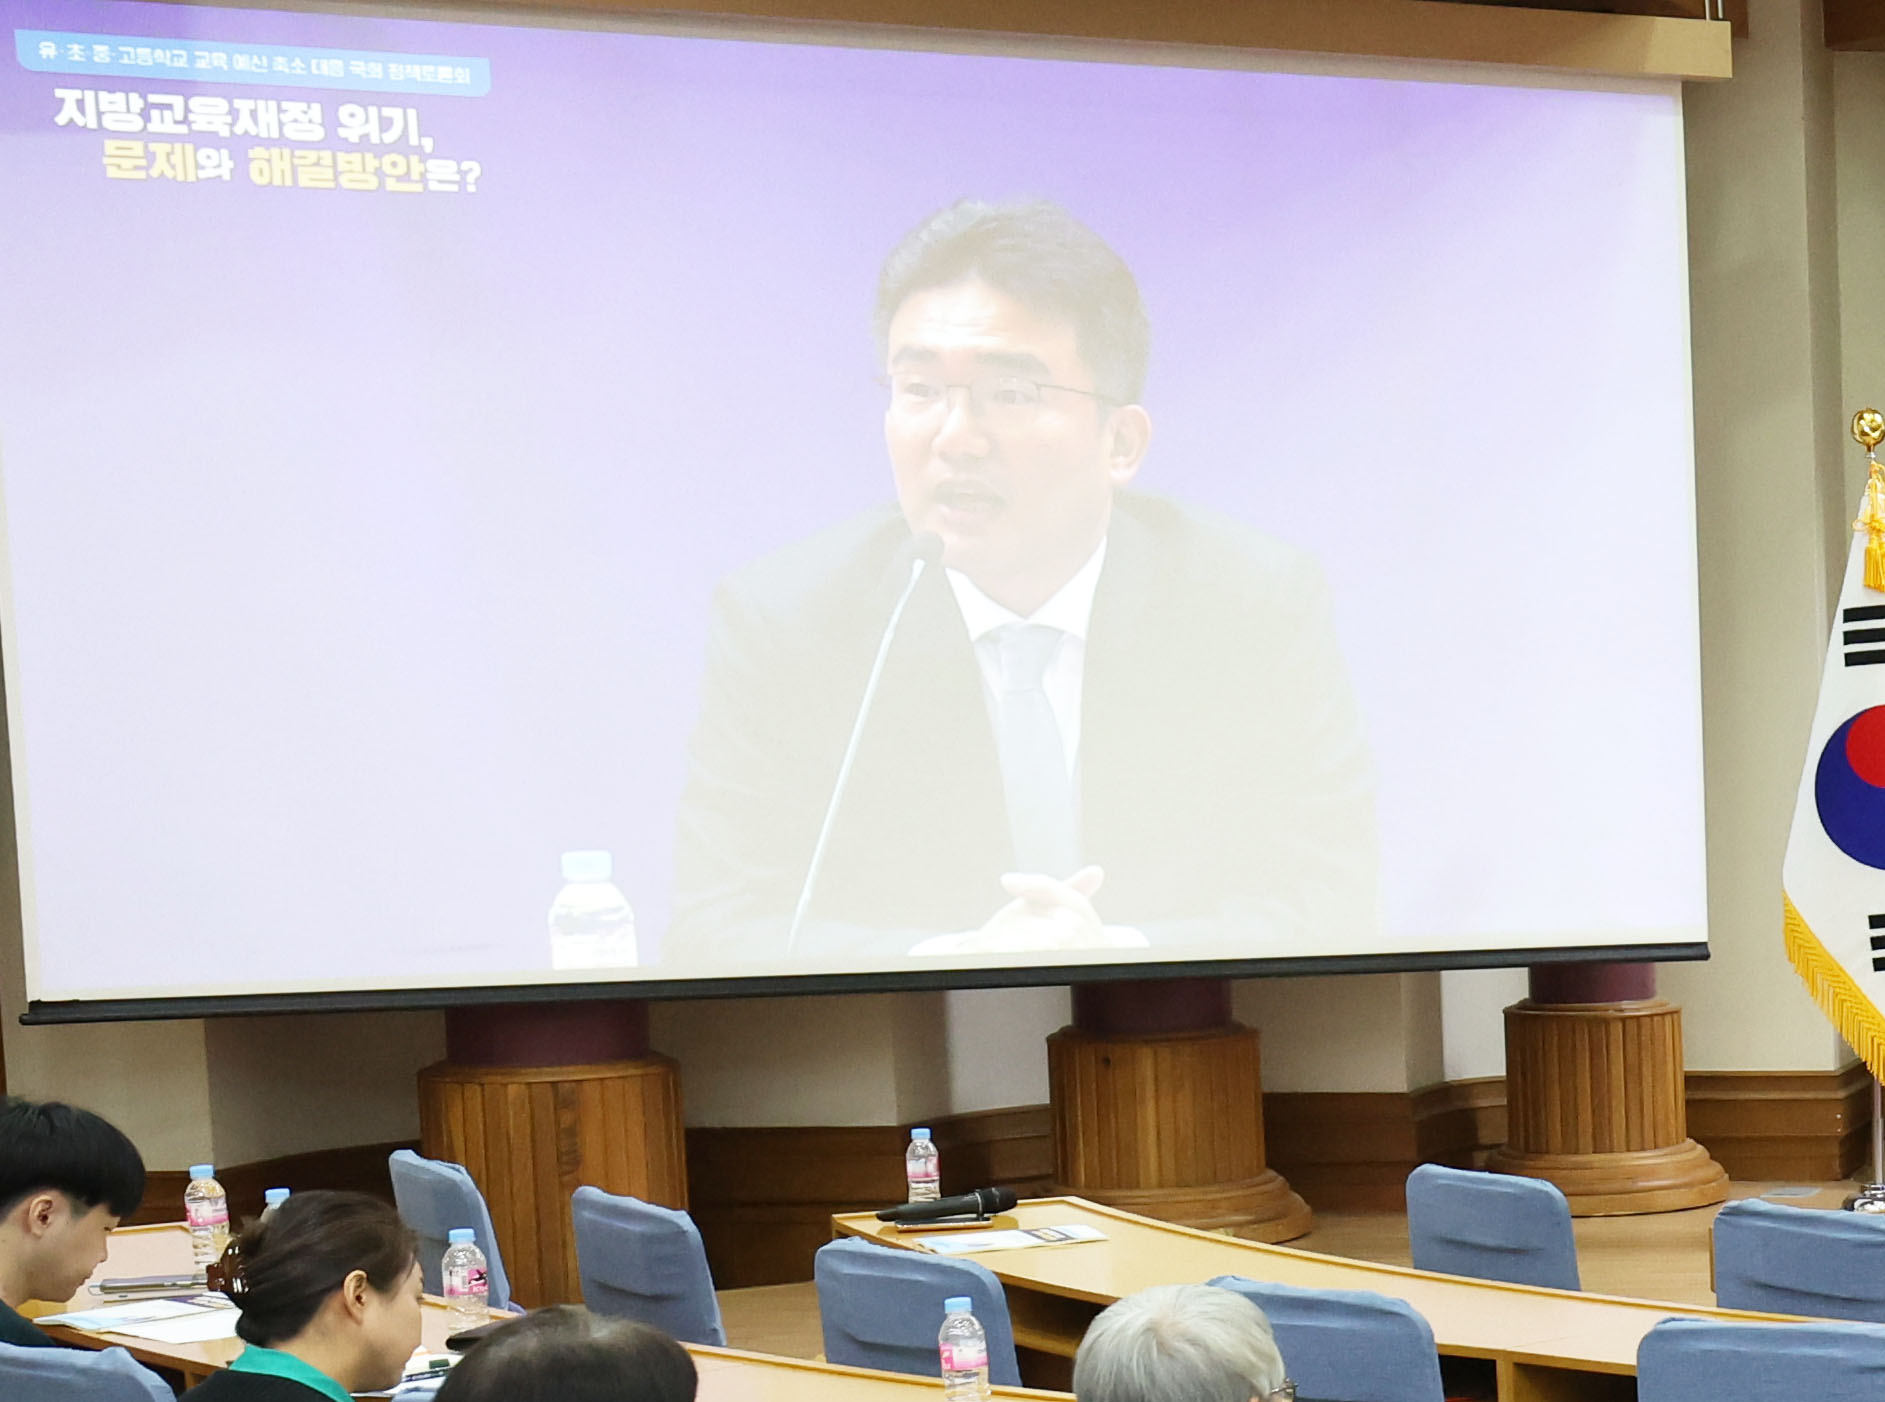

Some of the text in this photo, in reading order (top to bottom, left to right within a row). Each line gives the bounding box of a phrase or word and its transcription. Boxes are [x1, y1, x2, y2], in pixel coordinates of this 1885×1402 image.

[53, 87, 435, 153] 지방교육재정 위기,
[101, 139, 482, 193] 문제와 해결방안은?
